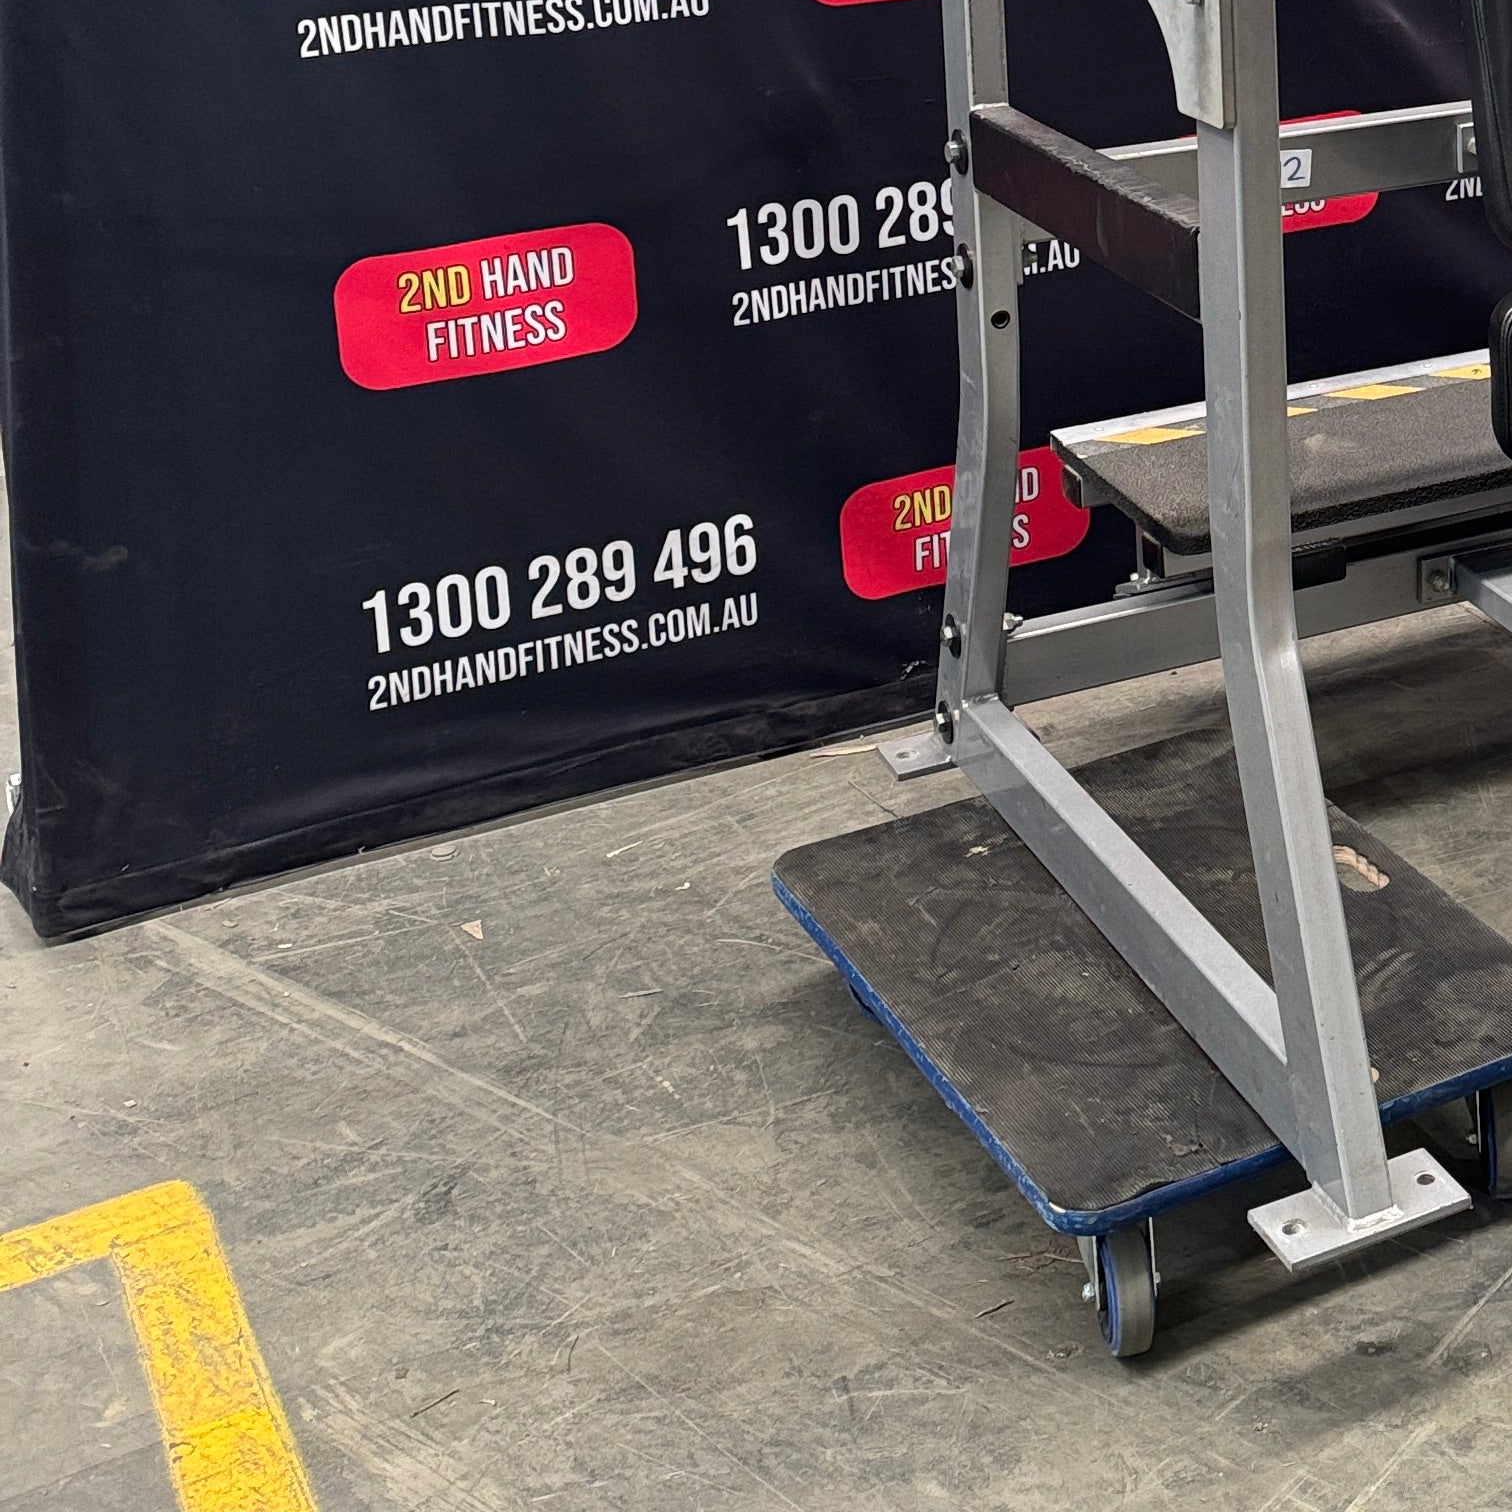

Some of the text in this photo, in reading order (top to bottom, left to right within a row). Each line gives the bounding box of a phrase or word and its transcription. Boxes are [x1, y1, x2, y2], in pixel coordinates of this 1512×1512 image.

[1283, 156, 1305, 181] 2
[726, 194, 860, 270] 1300
[398, 247, 574, 313] 2ND HAND
[426, 300, 566, 361] FITNESS
[893, 484, 951, 531] 2ND
[362, 513, 757, 654] 1300 289 496
[367, 591, 759, 712] 2NDHANDFITNESS.COM.AU
